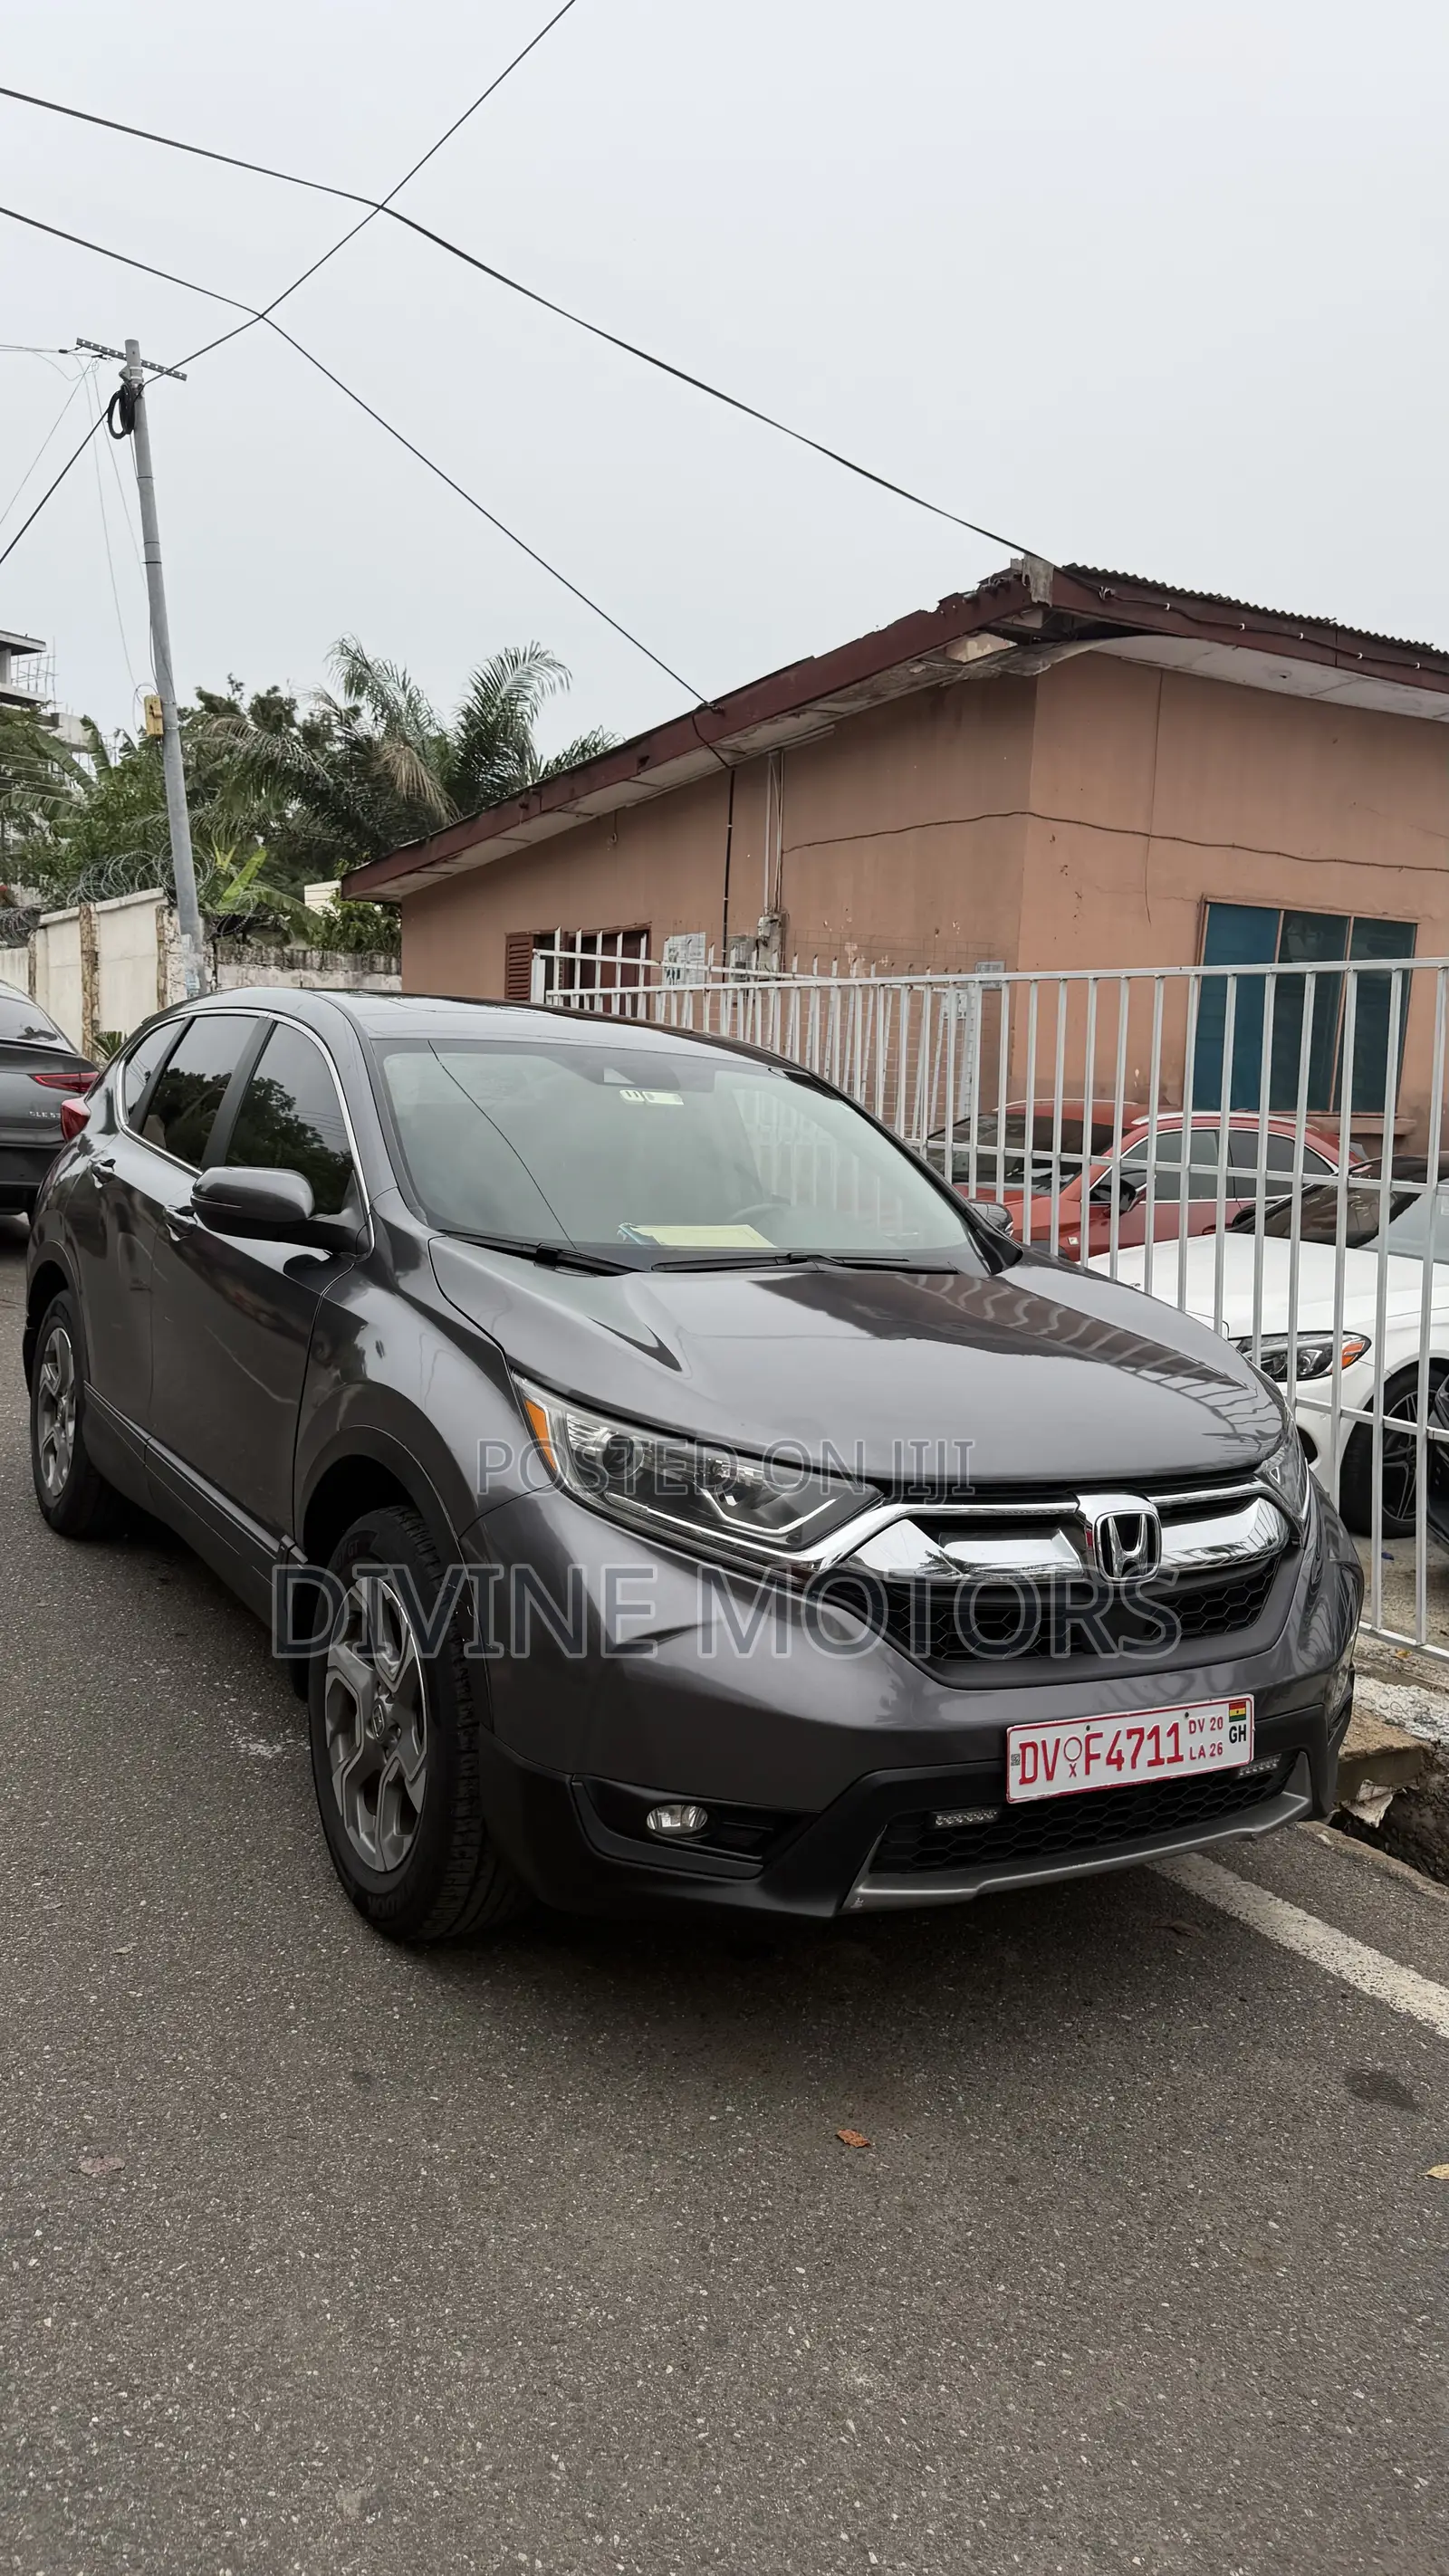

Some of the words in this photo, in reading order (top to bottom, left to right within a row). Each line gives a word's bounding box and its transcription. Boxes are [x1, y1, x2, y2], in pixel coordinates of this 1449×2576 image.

[1188, 1717, 1205, 1735] DV
[1210, 1716, 1224, 1731] 20
[1229, 1724, 1247, 1744] GH
[1018, 1738, 1060, 1786] DV
[1084, 1722, 1185, 1776] F4711
[1189, 1744, 1206, 1760] LA
[1209, 1741, 1223, 1757] 26
